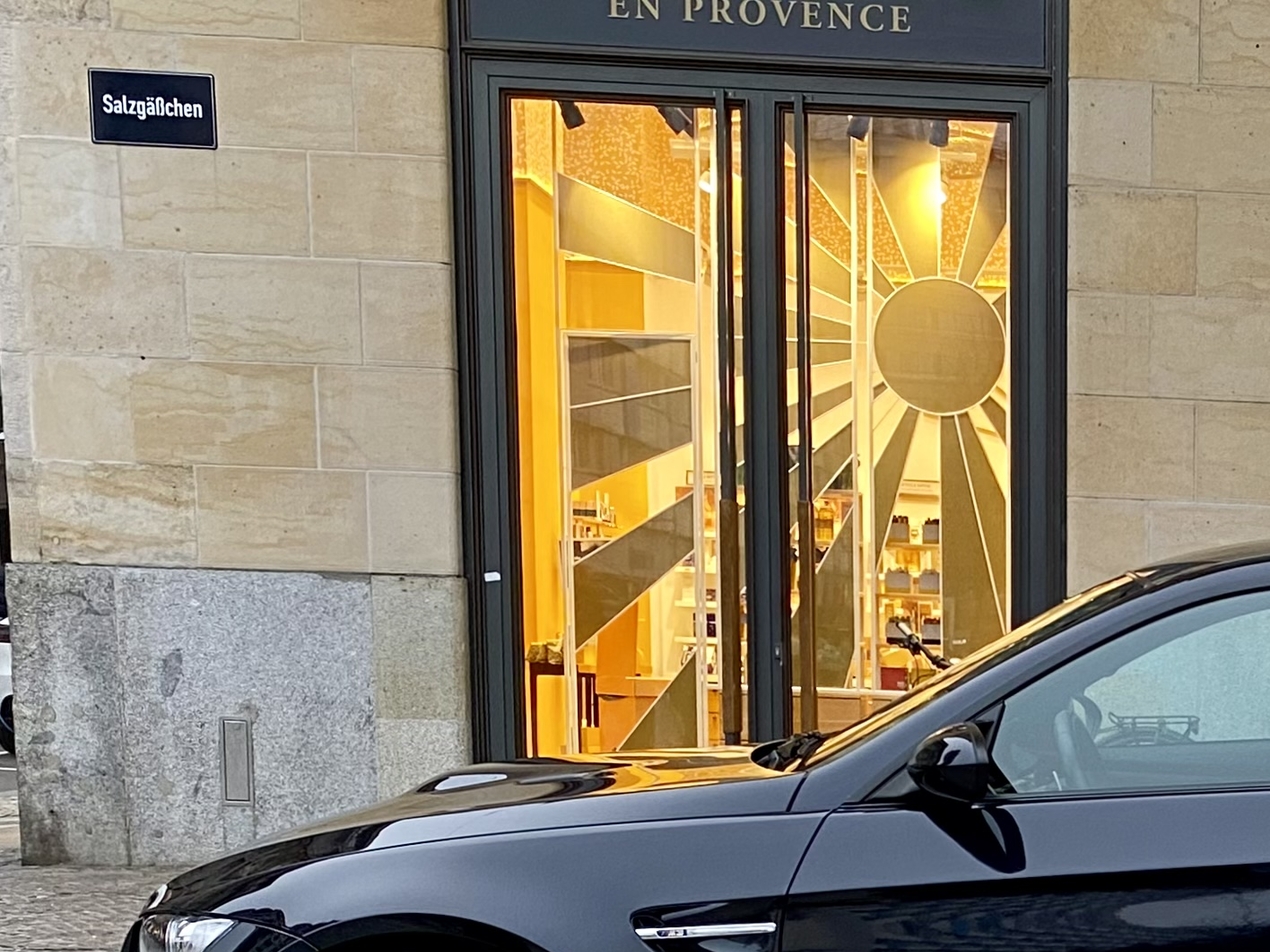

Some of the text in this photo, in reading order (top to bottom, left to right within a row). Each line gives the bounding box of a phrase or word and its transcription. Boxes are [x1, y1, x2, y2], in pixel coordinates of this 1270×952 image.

[607, 0, 911, 33] EN PROVENCE
[102, 93, 203, 120] Salzgäßchen
